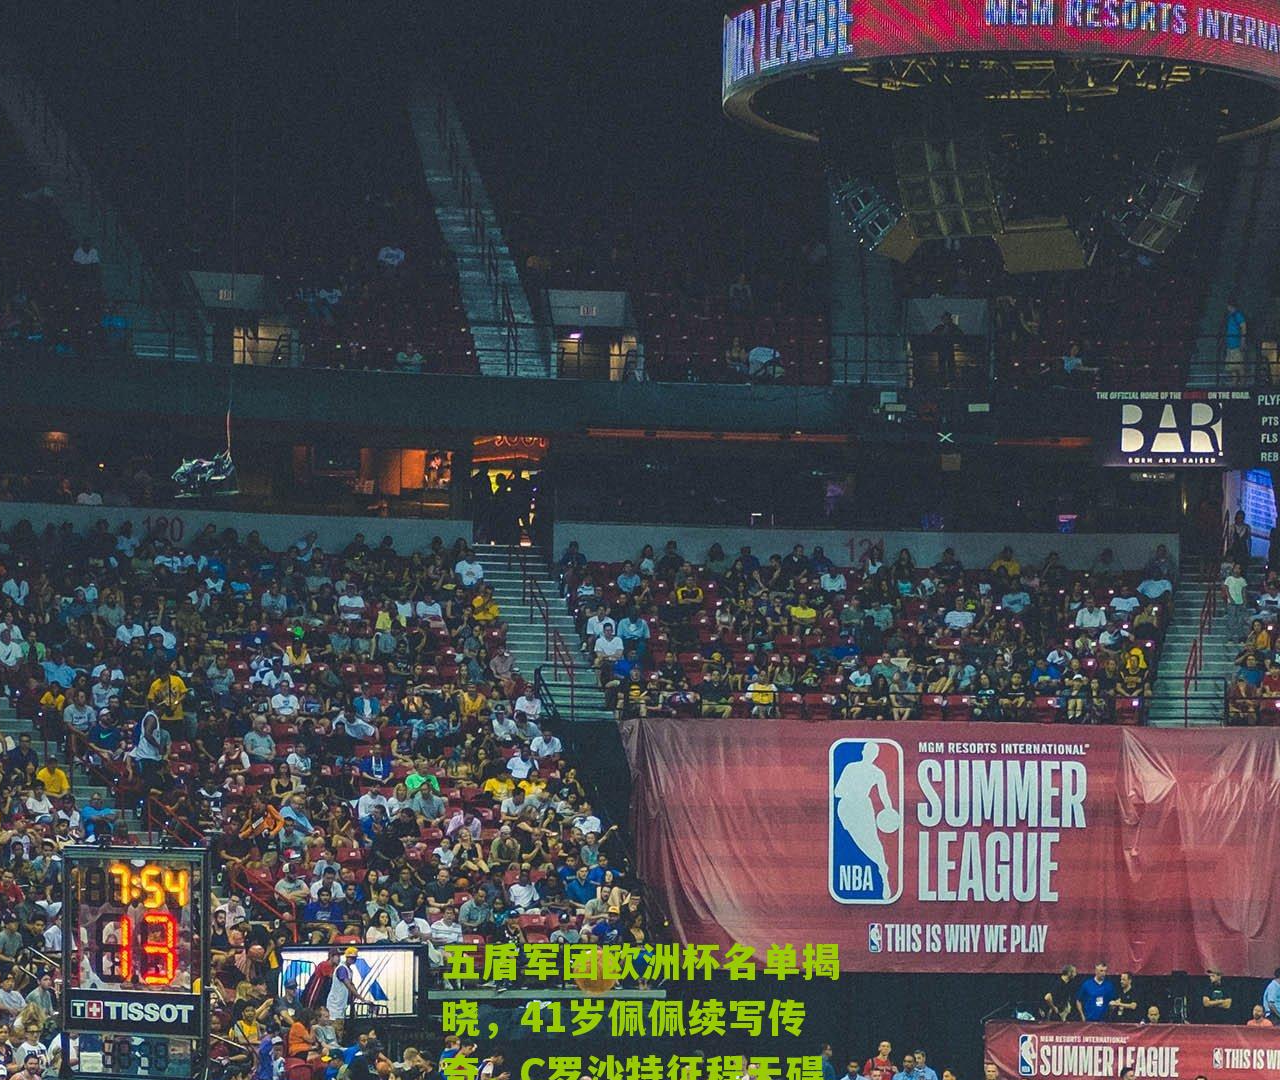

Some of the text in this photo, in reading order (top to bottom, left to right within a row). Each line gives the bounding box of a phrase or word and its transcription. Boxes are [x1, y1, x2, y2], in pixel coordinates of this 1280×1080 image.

[985, 0, 1054, 25] MGM
[1065, 0, 1187, 35] RESORTS
[1096, 392, 1108, 400] THE
[1109, 392, 1139, 400] OFFICIAL
[1160, 392, 1168, 400] OF
[1169, 392, 1181, 400] THE
[1208, 392, 1217, 400] ON
[1218, 392, 1230, 400] THE
[1261, 417, 1279, 426] PTS
[1261, 434, 1278, 443] FLS
[1261, 452, 1279, 462] REB
[918, 742, 1087, 755] MGM RESORTS INTERNATIONAL
[918, 761, 1086, 828] SUMMER
[839, 864, 874, 892] NBA
[919, 831, 1060, 902] LEAGUE
[108, 863, 189, 909] 7:54
[120, 912, 178, 986] 13
[885, 923, 1048, 954] THIS IS WHY WE PLAY
[108, 1002, 194, 1023] TISSOT
[1039, 1045, 1179, 1077] SUMMER LEAGUE
[1225, 1048, 1251, 1069] THIS
[1253, 1049, 1264, 1069] IS
